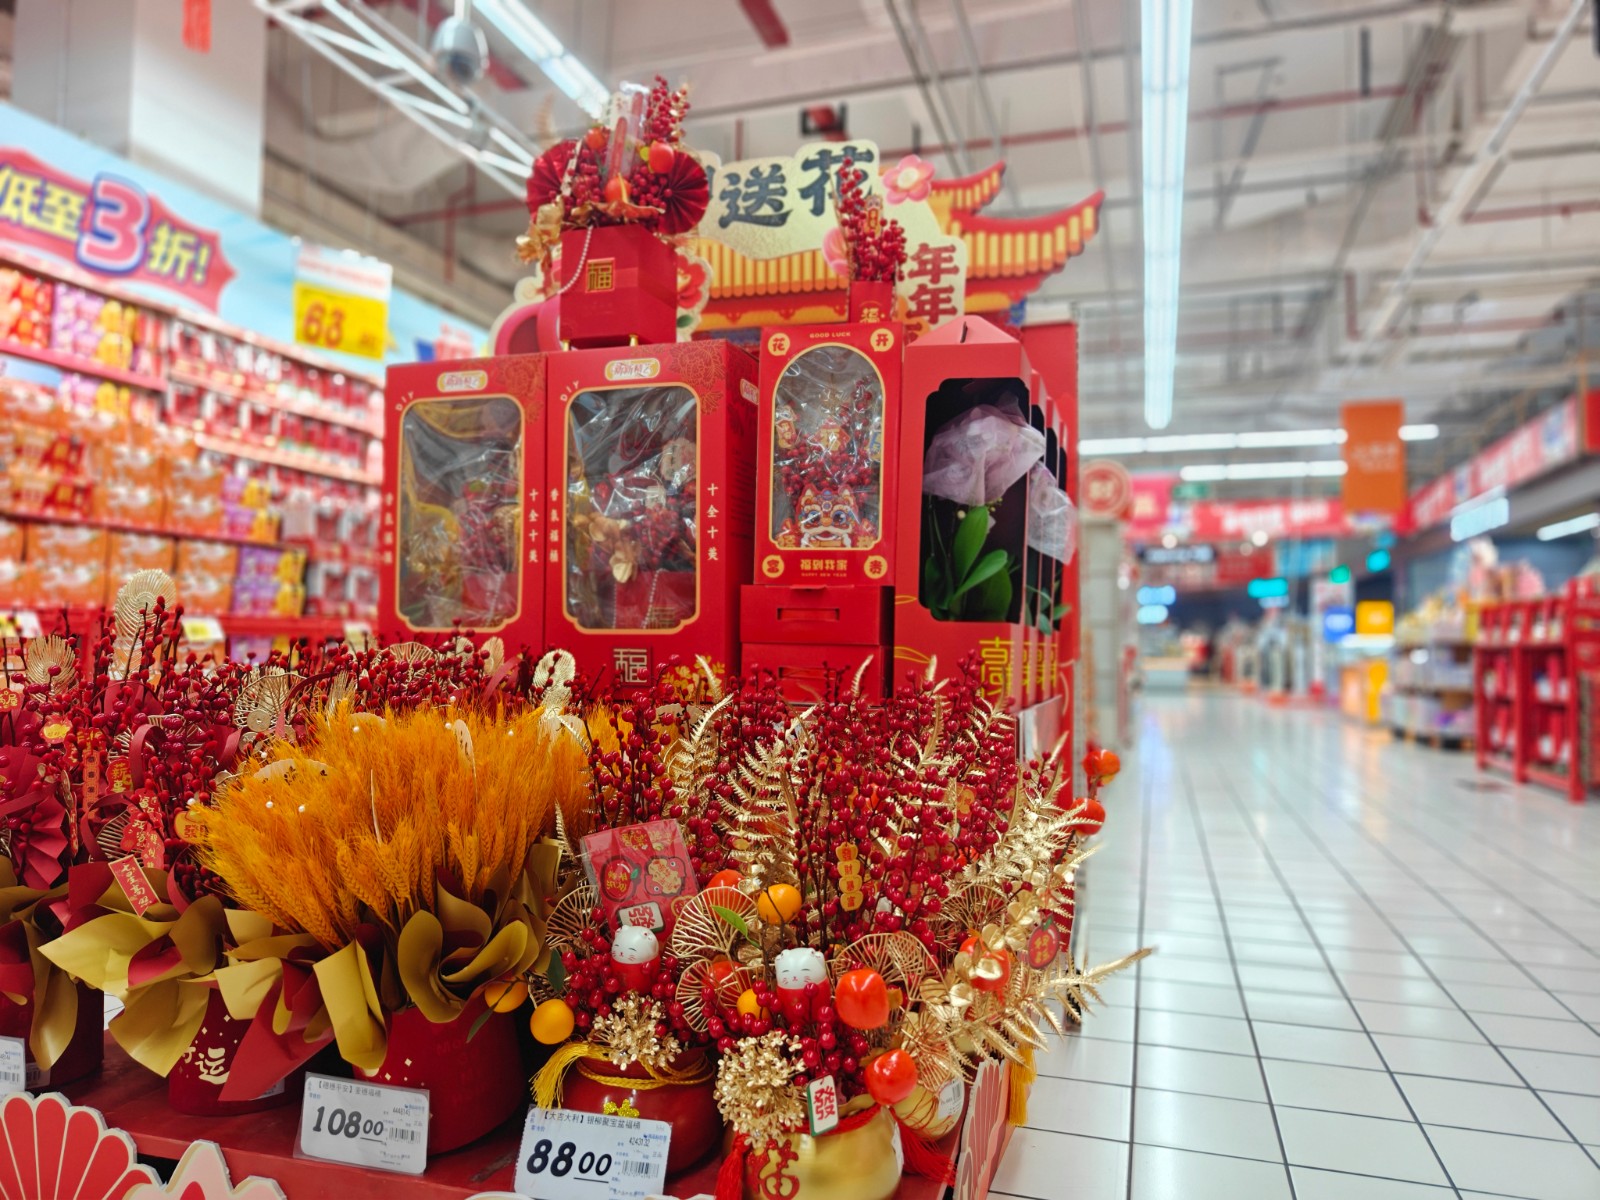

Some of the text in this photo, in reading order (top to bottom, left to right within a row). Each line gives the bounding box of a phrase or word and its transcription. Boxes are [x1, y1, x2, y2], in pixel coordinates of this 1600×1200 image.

[705, 146, 875, 230] 送花
[587, 261, 614, 291] 福
[907, 243, 960, 332] 年年
[772, 337, 786, 352] 花
[875, 333, 889, 347] 开
[706, 482, 720, 561] 十全十美
[813, 1085, 836, 1121] 發
[312, 1105, 362, 1139] 108
[526, 1138, 613, 1178] 88 00
